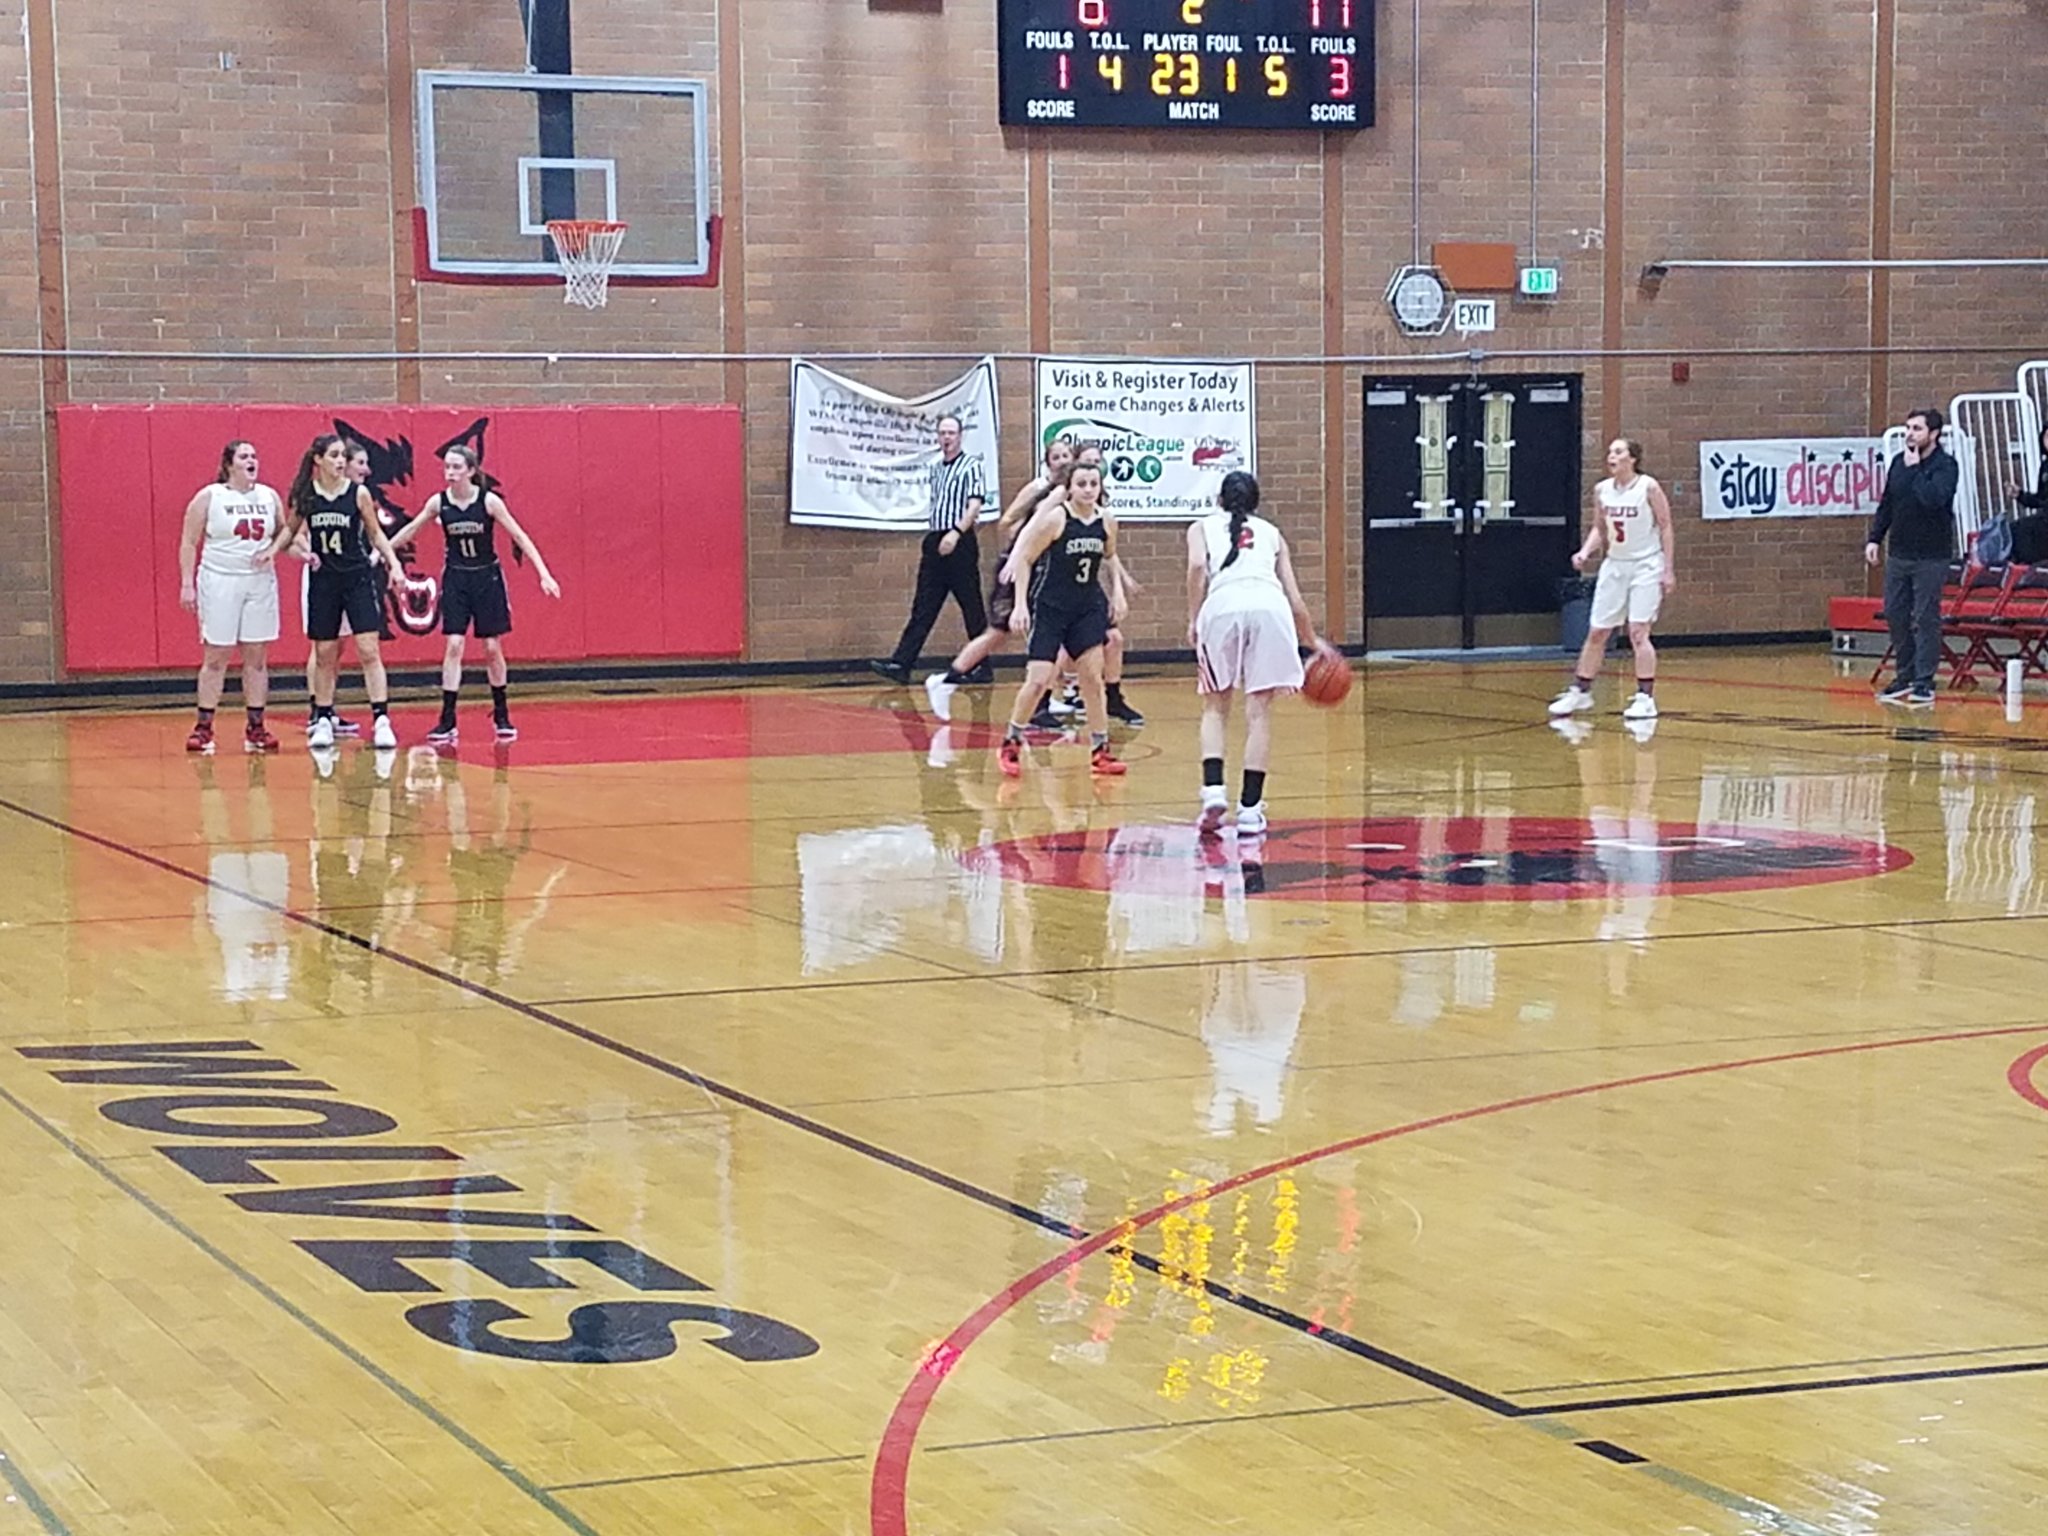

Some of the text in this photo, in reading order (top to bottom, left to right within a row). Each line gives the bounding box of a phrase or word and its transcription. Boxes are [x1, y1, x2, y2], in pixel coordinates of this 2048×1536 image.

[1026, 31, 1074, 49] FOULS
[1088, 32, 1130, 50] T.O.L.
[1143, 33, 1243, 52] PLAYER FOUL
[1256, 35, 1296, 53] T.O.L.
[1310, 37, 1356, 54] FOULS
[1058, 54, 1068, 90] 1
[1098, 54, 1122, 91] 4
[1151, 53, 1200, 95] 23
[1226, 57, 1237, 92] 1
[1264, 55, 1288, 96] 5
[1329, 57, 1350, 96] 3
[1027, 99, 1075, 118] SCORE
[1169, 101, 1219, 119] MATCH
[1310, 104, 1356, 121] SCORE
[1458, 303, 1491, 326] EXIT
[1052, 369, 1239, 394] Visit & Register Today
[1044, 395, 1246, 416] For Game Changes & Alerts
[1061, 432, 1185, 455] OlpicLeague
[1146, 496, 1203, 512] Standings
[234, 518, 265, 541] 45
[1613, 521, 1625, 543] 5
[320, 531, 342, 554] 14
[459, 538, 477, 558] 11
[1076, 558, 1092, 582] 3
[14, 1040, 821, 1364] WOLVES
